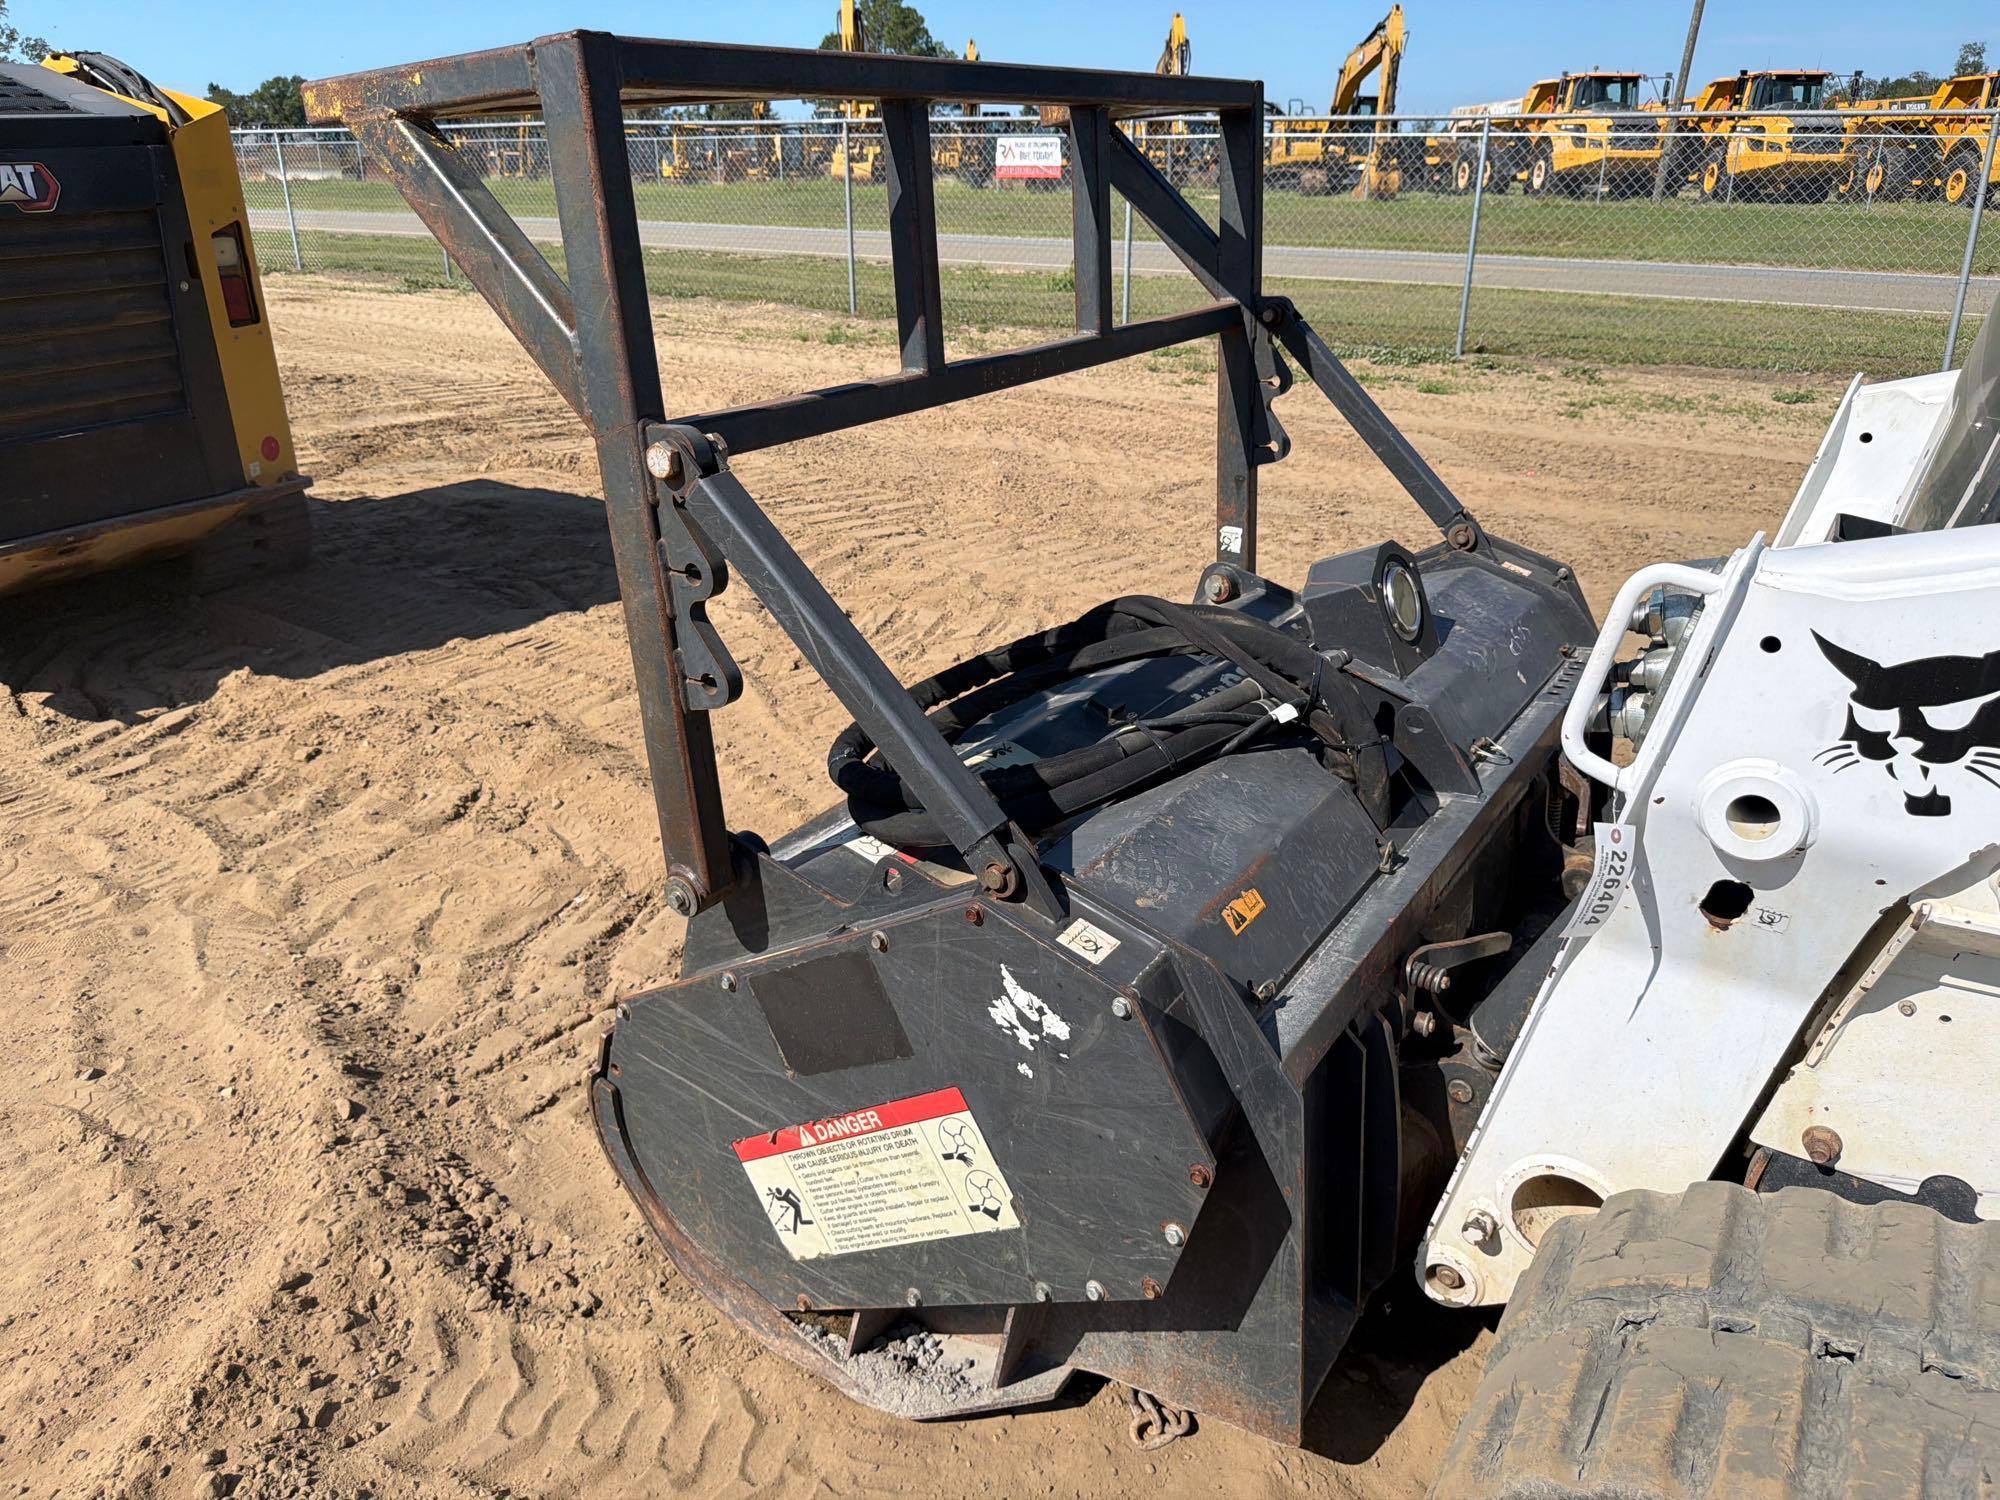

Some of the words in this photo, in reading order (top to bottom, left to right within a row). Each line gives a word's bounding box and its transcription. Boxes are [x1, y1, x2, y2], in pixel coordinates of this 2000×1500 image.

[0, 164, 38, 200] AT
[1584, 851, 1628, 925] 226404
[816, 1110, 882, 1141] DANGER
[788, 1150, 816, 1162] THROWN
[816, 1143, 846, 1156] OBJECTS
[845, 1140, 857, 1149] OR
[856, 1132, 890, 1146] ROTATING
[889, 1127, 913, 1138] DRUM
[792, 1162, 807, 1171] CAN
[806, 1156, 829, 1168] CAUSE
[828, 1150, 858, 1163] SERIOUS
[856, 1144, 882, 1156] INJURY
[882, 1141, 894, 1150] OR
[893, 1136, 918, 1148] DEATH
